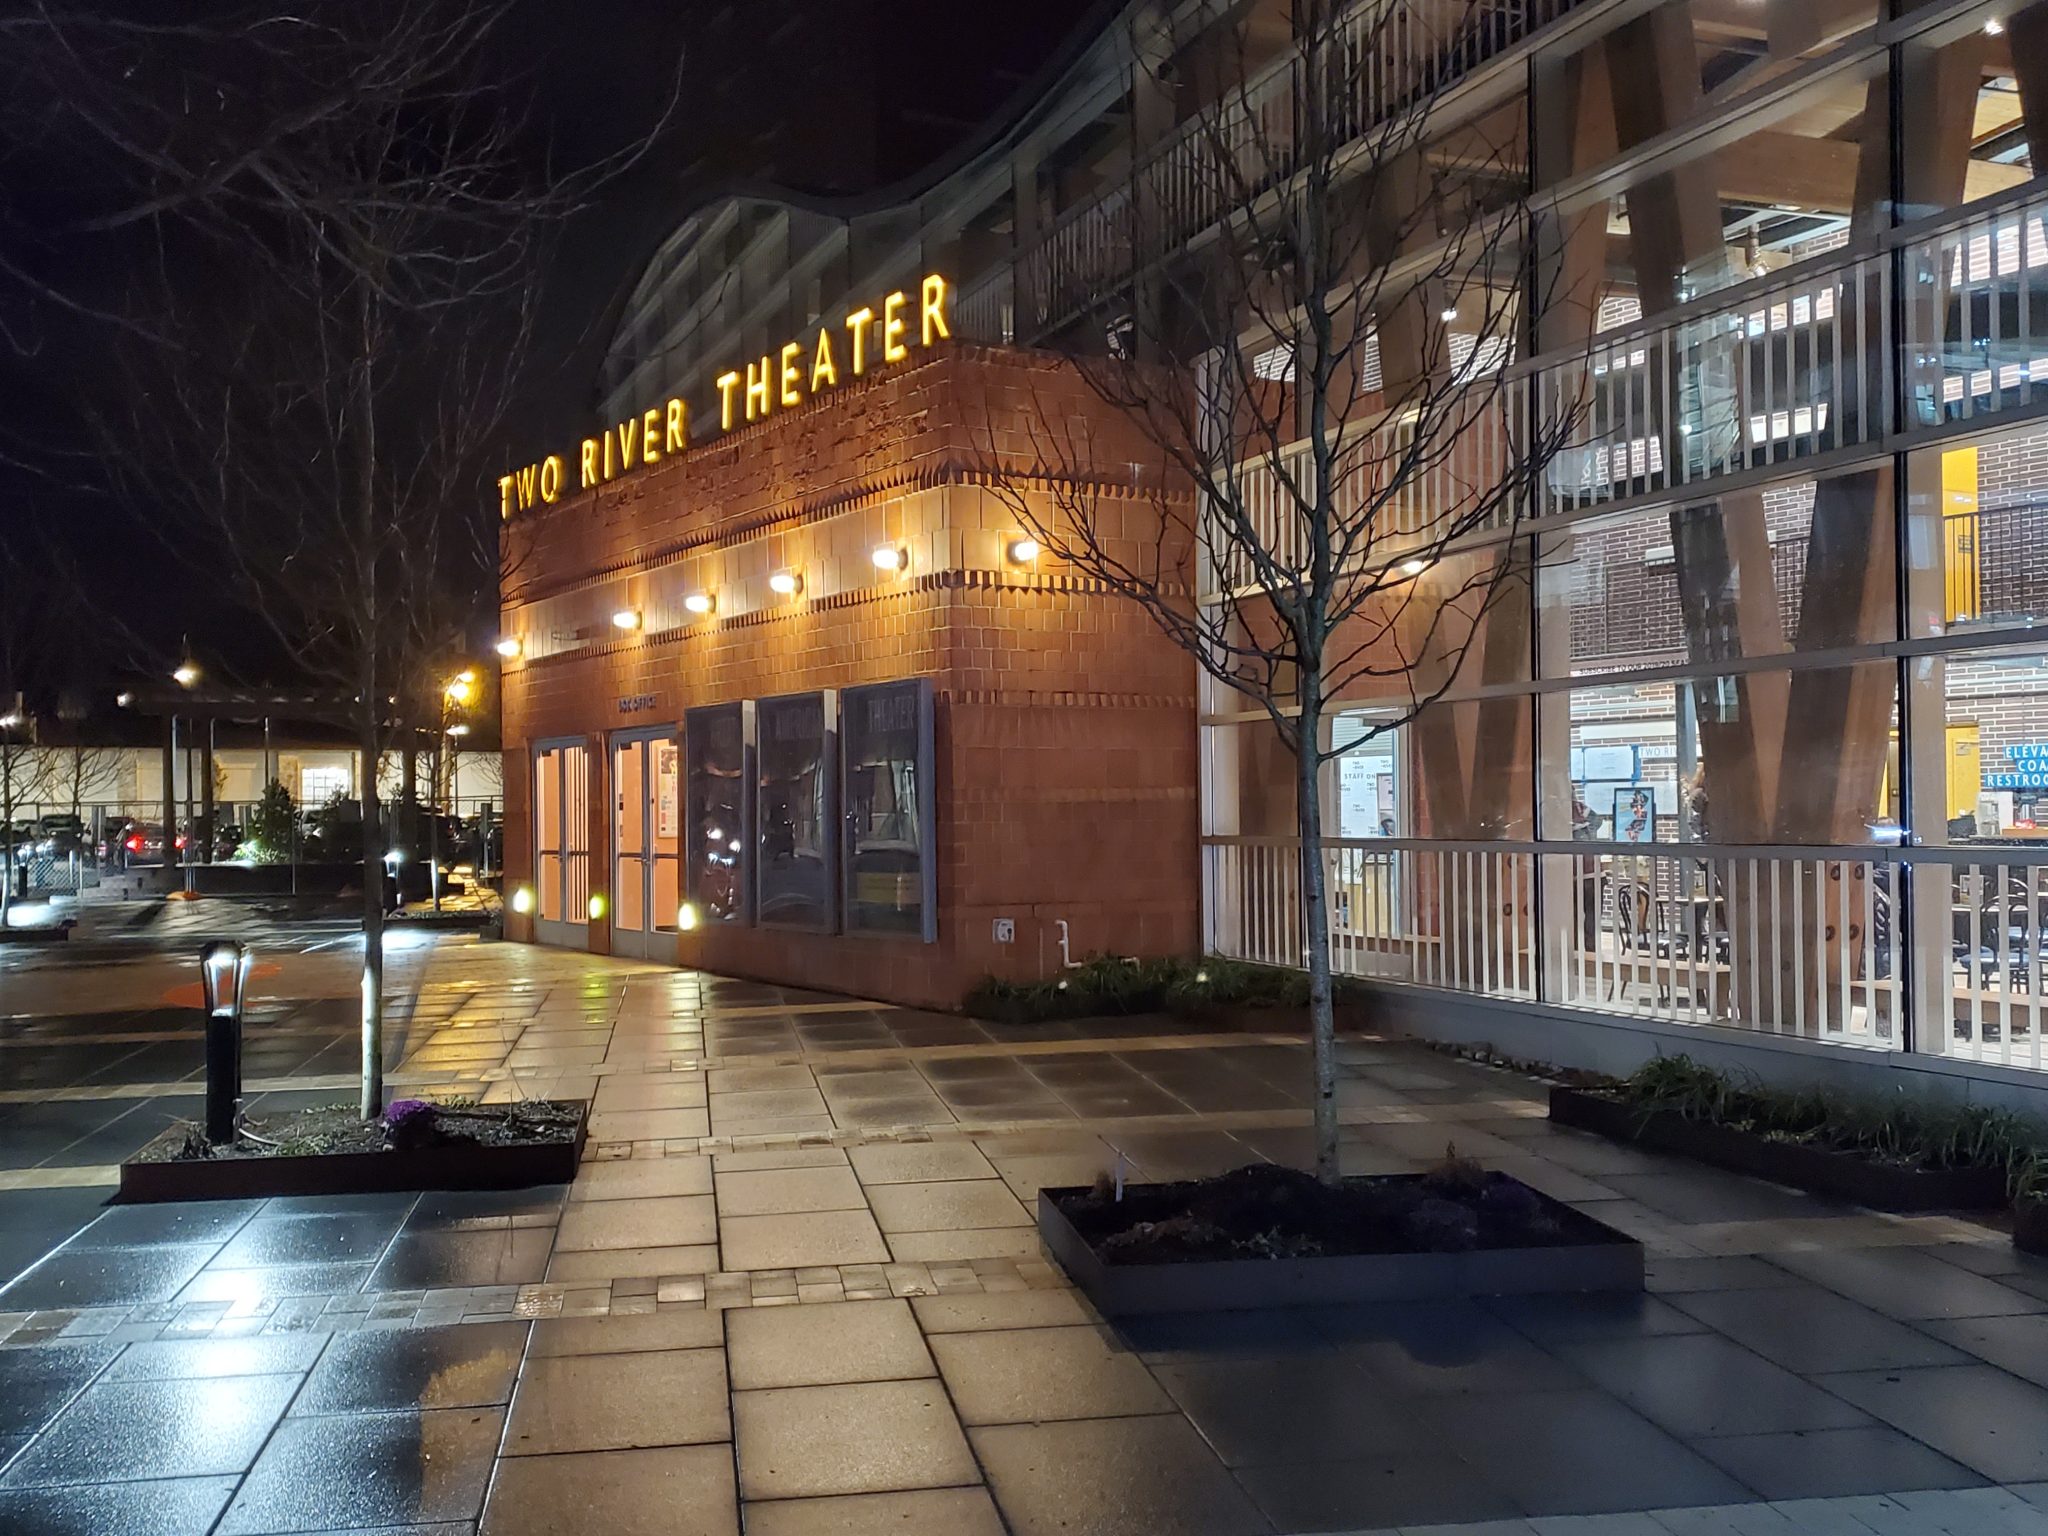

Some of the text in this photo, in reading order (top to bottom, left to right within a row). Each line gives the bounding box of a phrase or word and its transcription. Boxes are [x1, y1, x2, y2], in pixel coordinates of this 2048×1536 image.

[498, 273, 950, 519] TWO RIVER THEATER
[1640, 746, 1660, 757] TWO
[2005, 745, 2048, 758] ELEVA
[2018, 759, 2048, 772] COA
